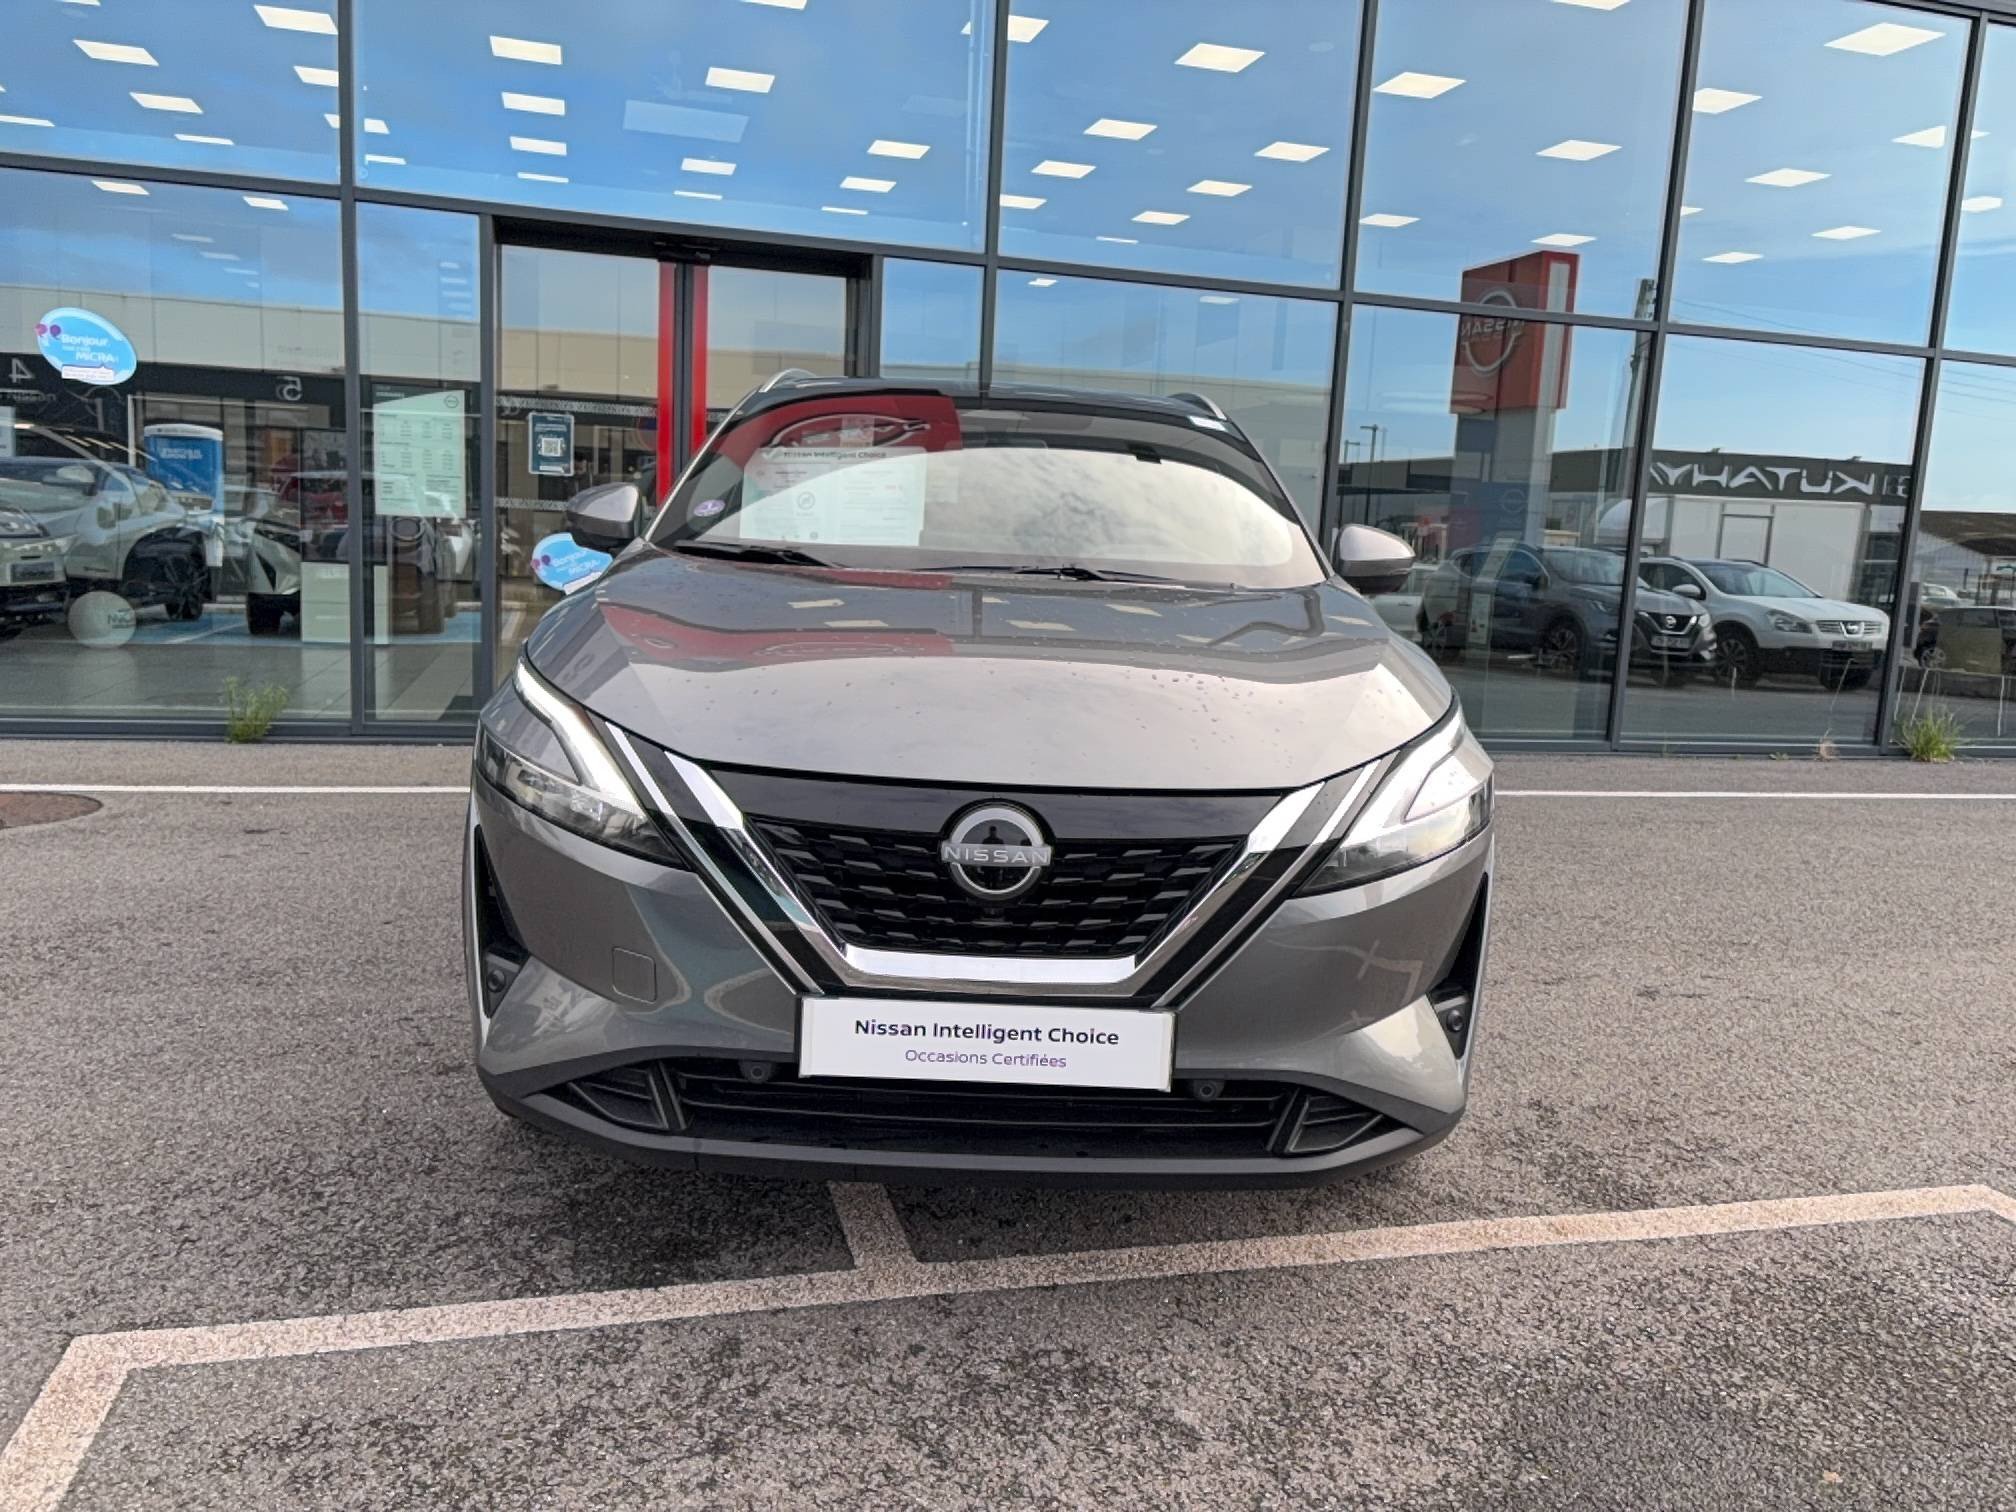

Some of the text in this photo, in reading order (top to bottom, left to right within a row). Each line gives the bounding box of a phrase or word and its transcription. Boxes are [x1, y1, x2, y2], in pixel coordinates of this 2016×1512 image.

[944, 845, 1049, 864] NISSAN
[855, 1019, 1119, 1045] Nissan Intelligent Choice
[905, 1049, 1067, 1068] Occasions Certifiées
